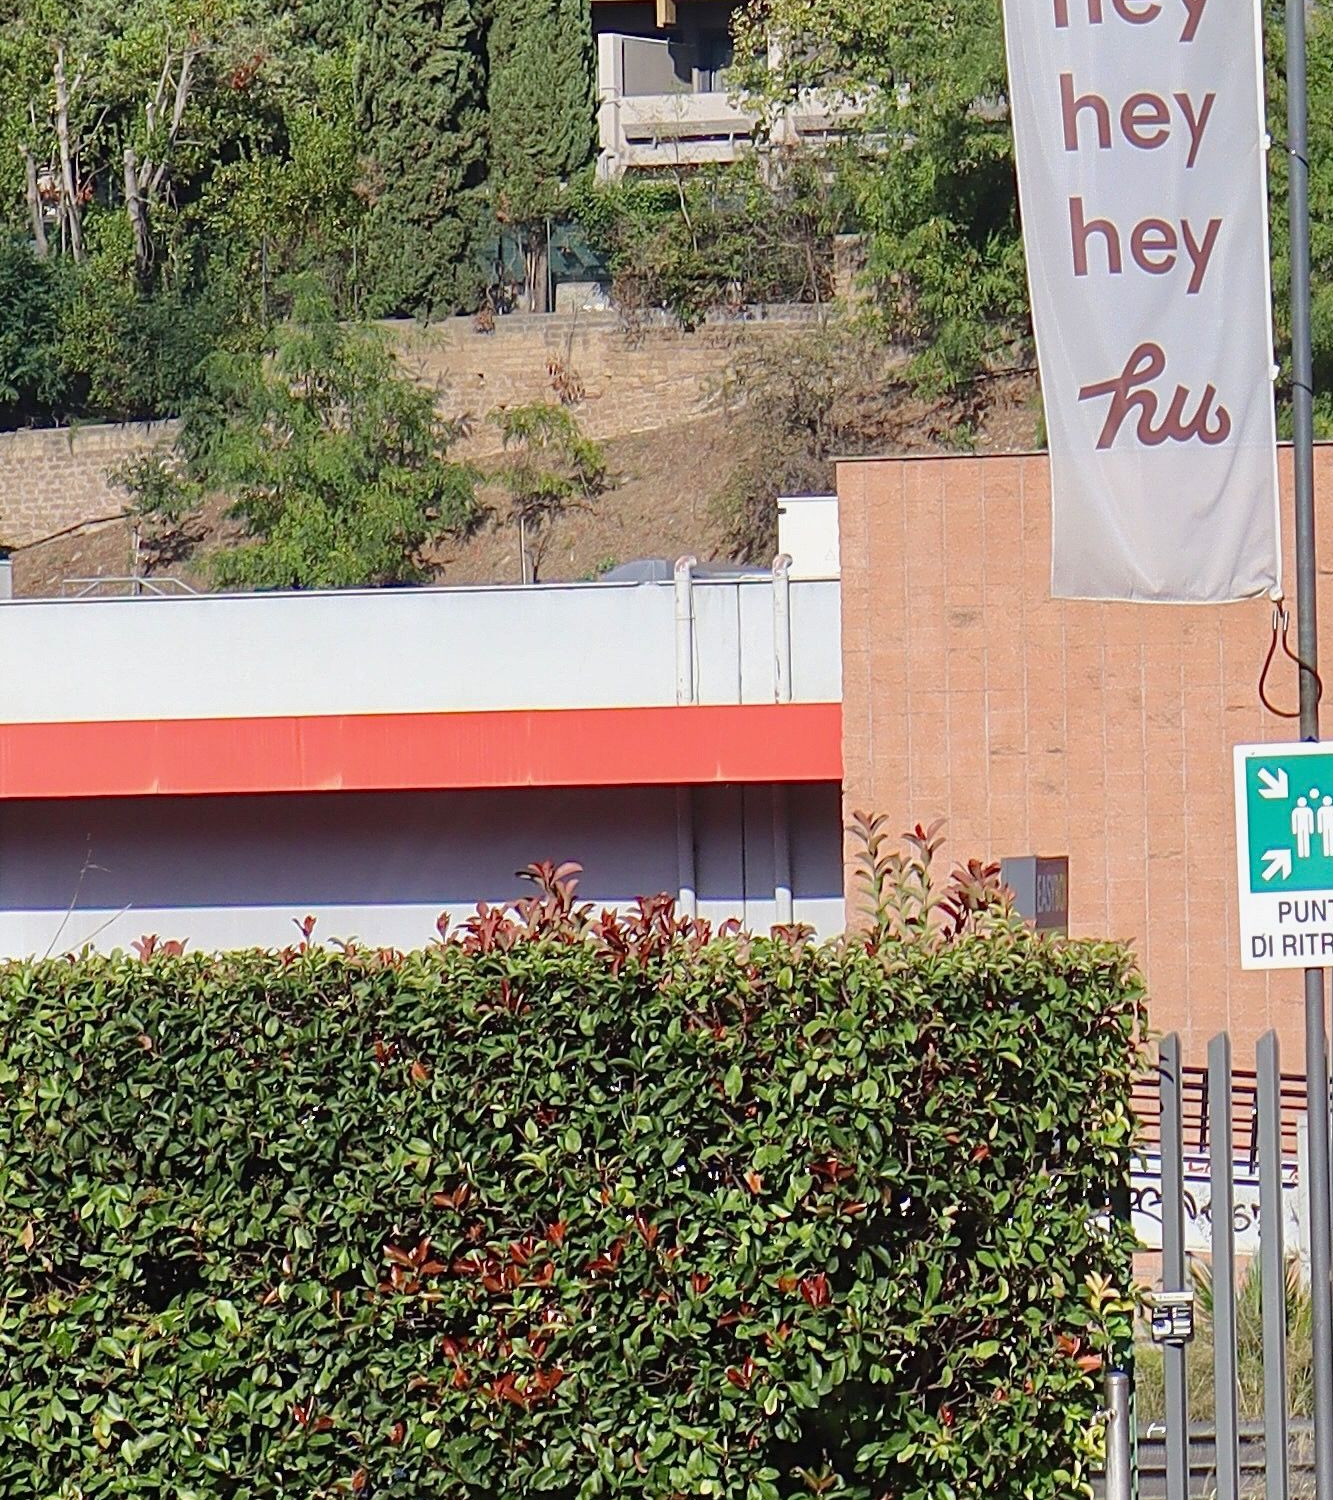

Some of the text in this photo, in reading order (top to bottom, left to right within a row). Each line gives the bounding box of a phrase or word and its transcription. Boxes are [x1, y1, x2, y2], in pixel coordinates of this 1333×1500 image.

[1059, 73, 1215, 169] hey
[1068, 197, 1222, 295] hey
[1078, 342, 1232, 450] hu
[1251, 934, 1273, 959] DI
